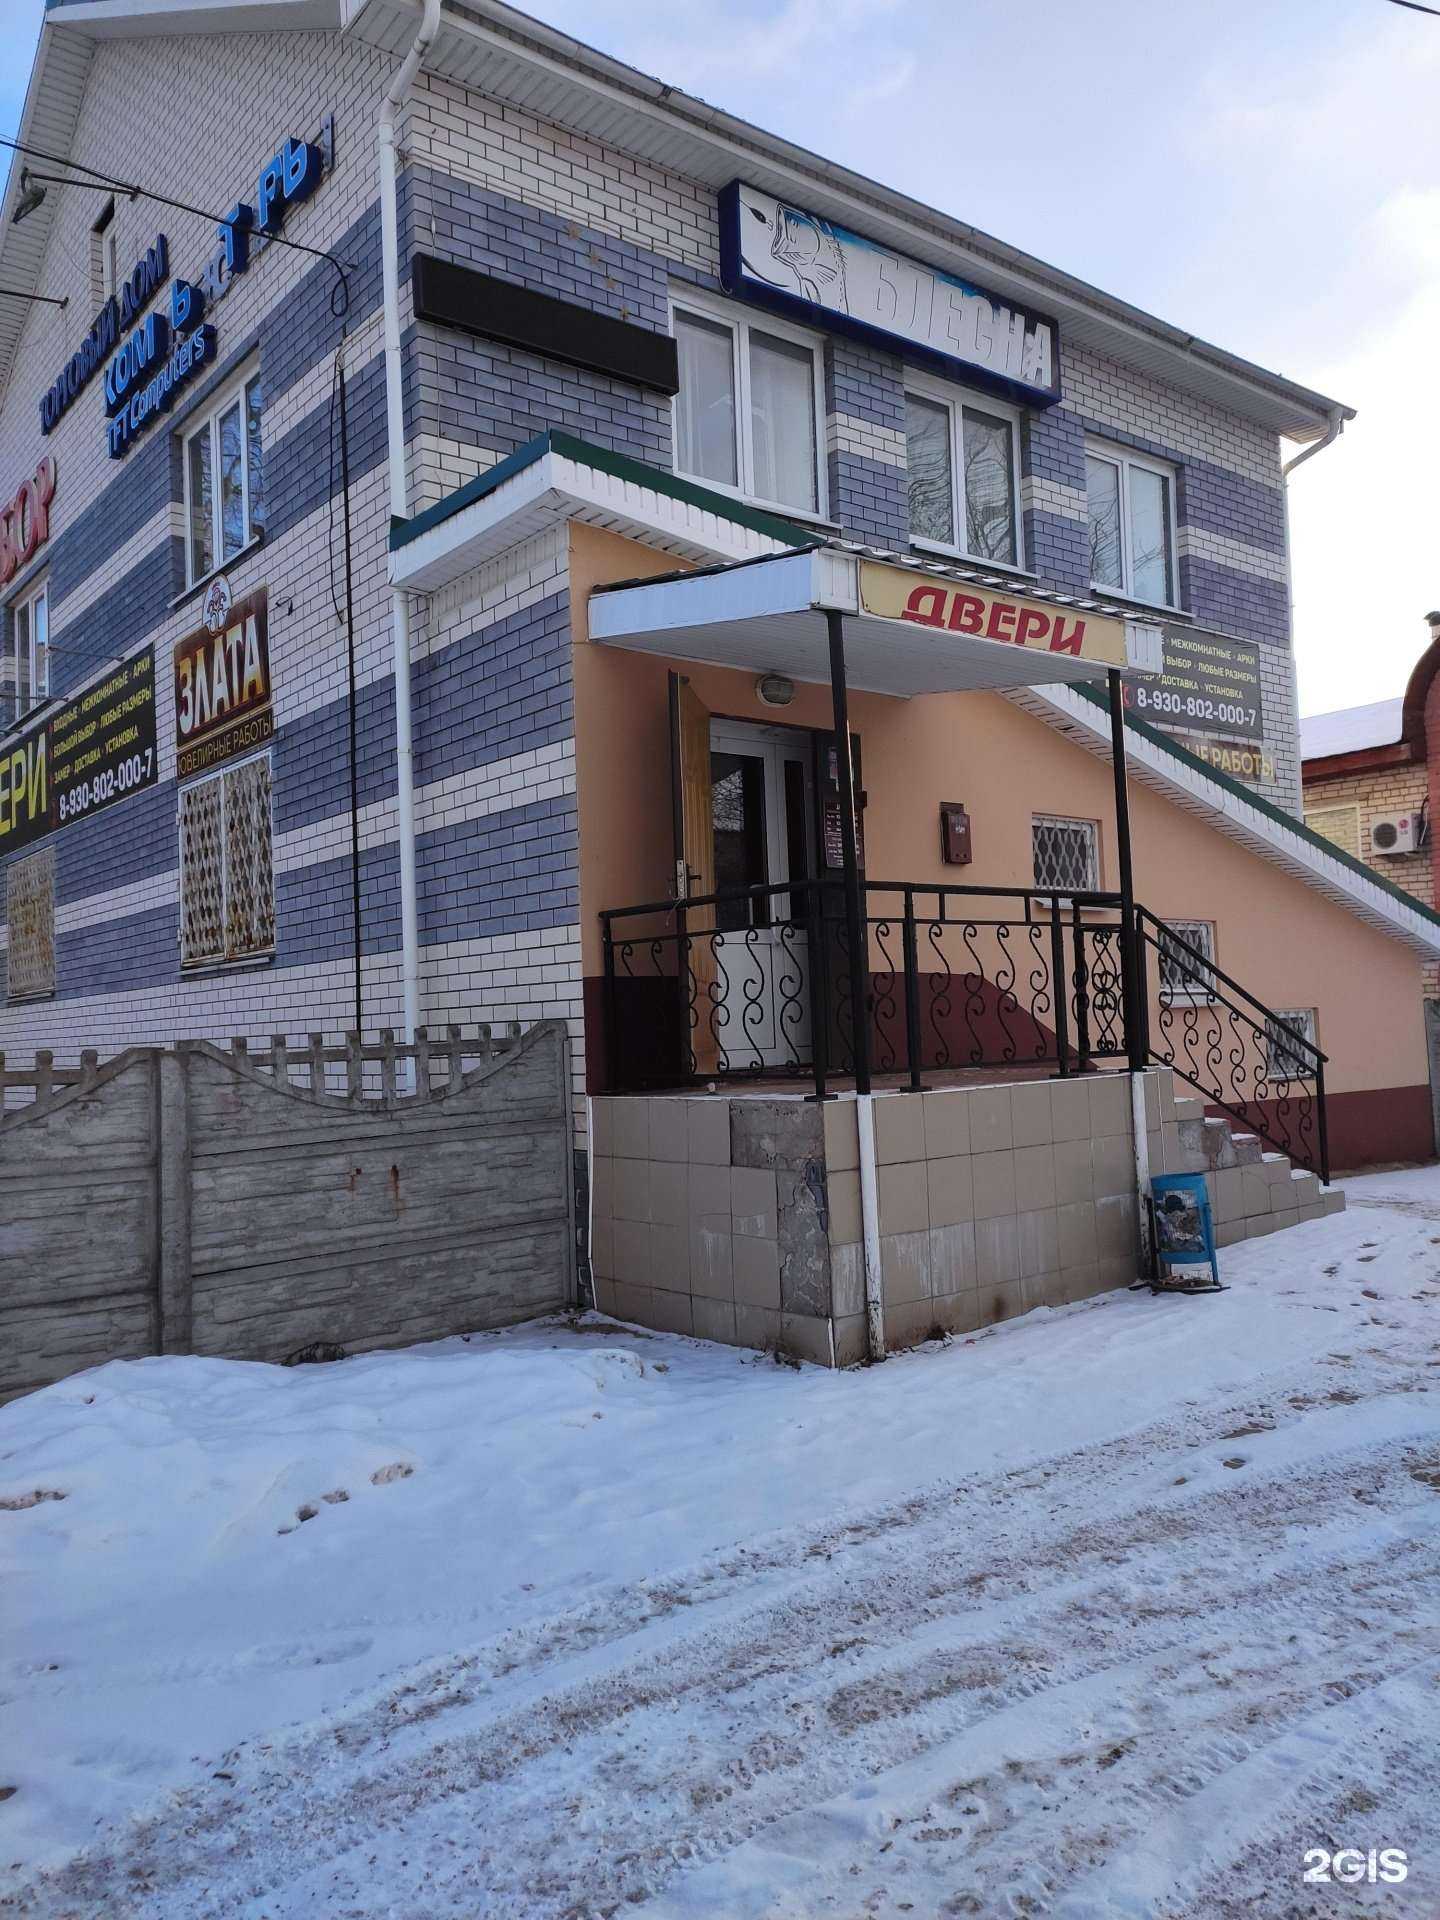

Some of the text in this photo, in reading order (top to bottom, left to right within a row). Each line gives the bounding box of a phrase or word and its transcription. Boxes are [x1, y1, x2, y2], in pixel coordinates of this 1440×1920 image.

[121, 234, 169, 333] ДОМ
[130, 324, 209, 427] Computers
[901, 585, 1086, 656] ДВЕРИ
[132, 656, 150, 679] АРКИ
[179, 614, 264, 735] ЗЛАТА
[1166, 656, 1257, 683] ВЫБОР ЛЮБЫЕ РАЗМЕРЫ
[1171, 638, 1232, 660] МЕЖКОМНАТНЫЕ
[1236, 652, 1255, 665] АРКИ
[1137, 687, 1256, 727] 8-930-802-000-7
[1161, 674, 1199, 690] ДОСТАВКА
[1204, 682, 1244, 699] УСТАНОВКА
[78, 720, 97, 745] ВЫБОР
[100, 706, 122, 729] ЛЮБЫЕ
[122, 685, 152, 716] РАЗМЕРЫ
[74, 747, 101, 776] ДОСТАВКА
[104, 725, 139, 754] УСТАНОВКА
[178, 715, 272, 775] ЮВЕЛИРНЫЕ РАБОТЫ
[1212, 748, 1274, 777] РАБОТЫ
[59, 747, 152, 820] 8-930-802-000-7
